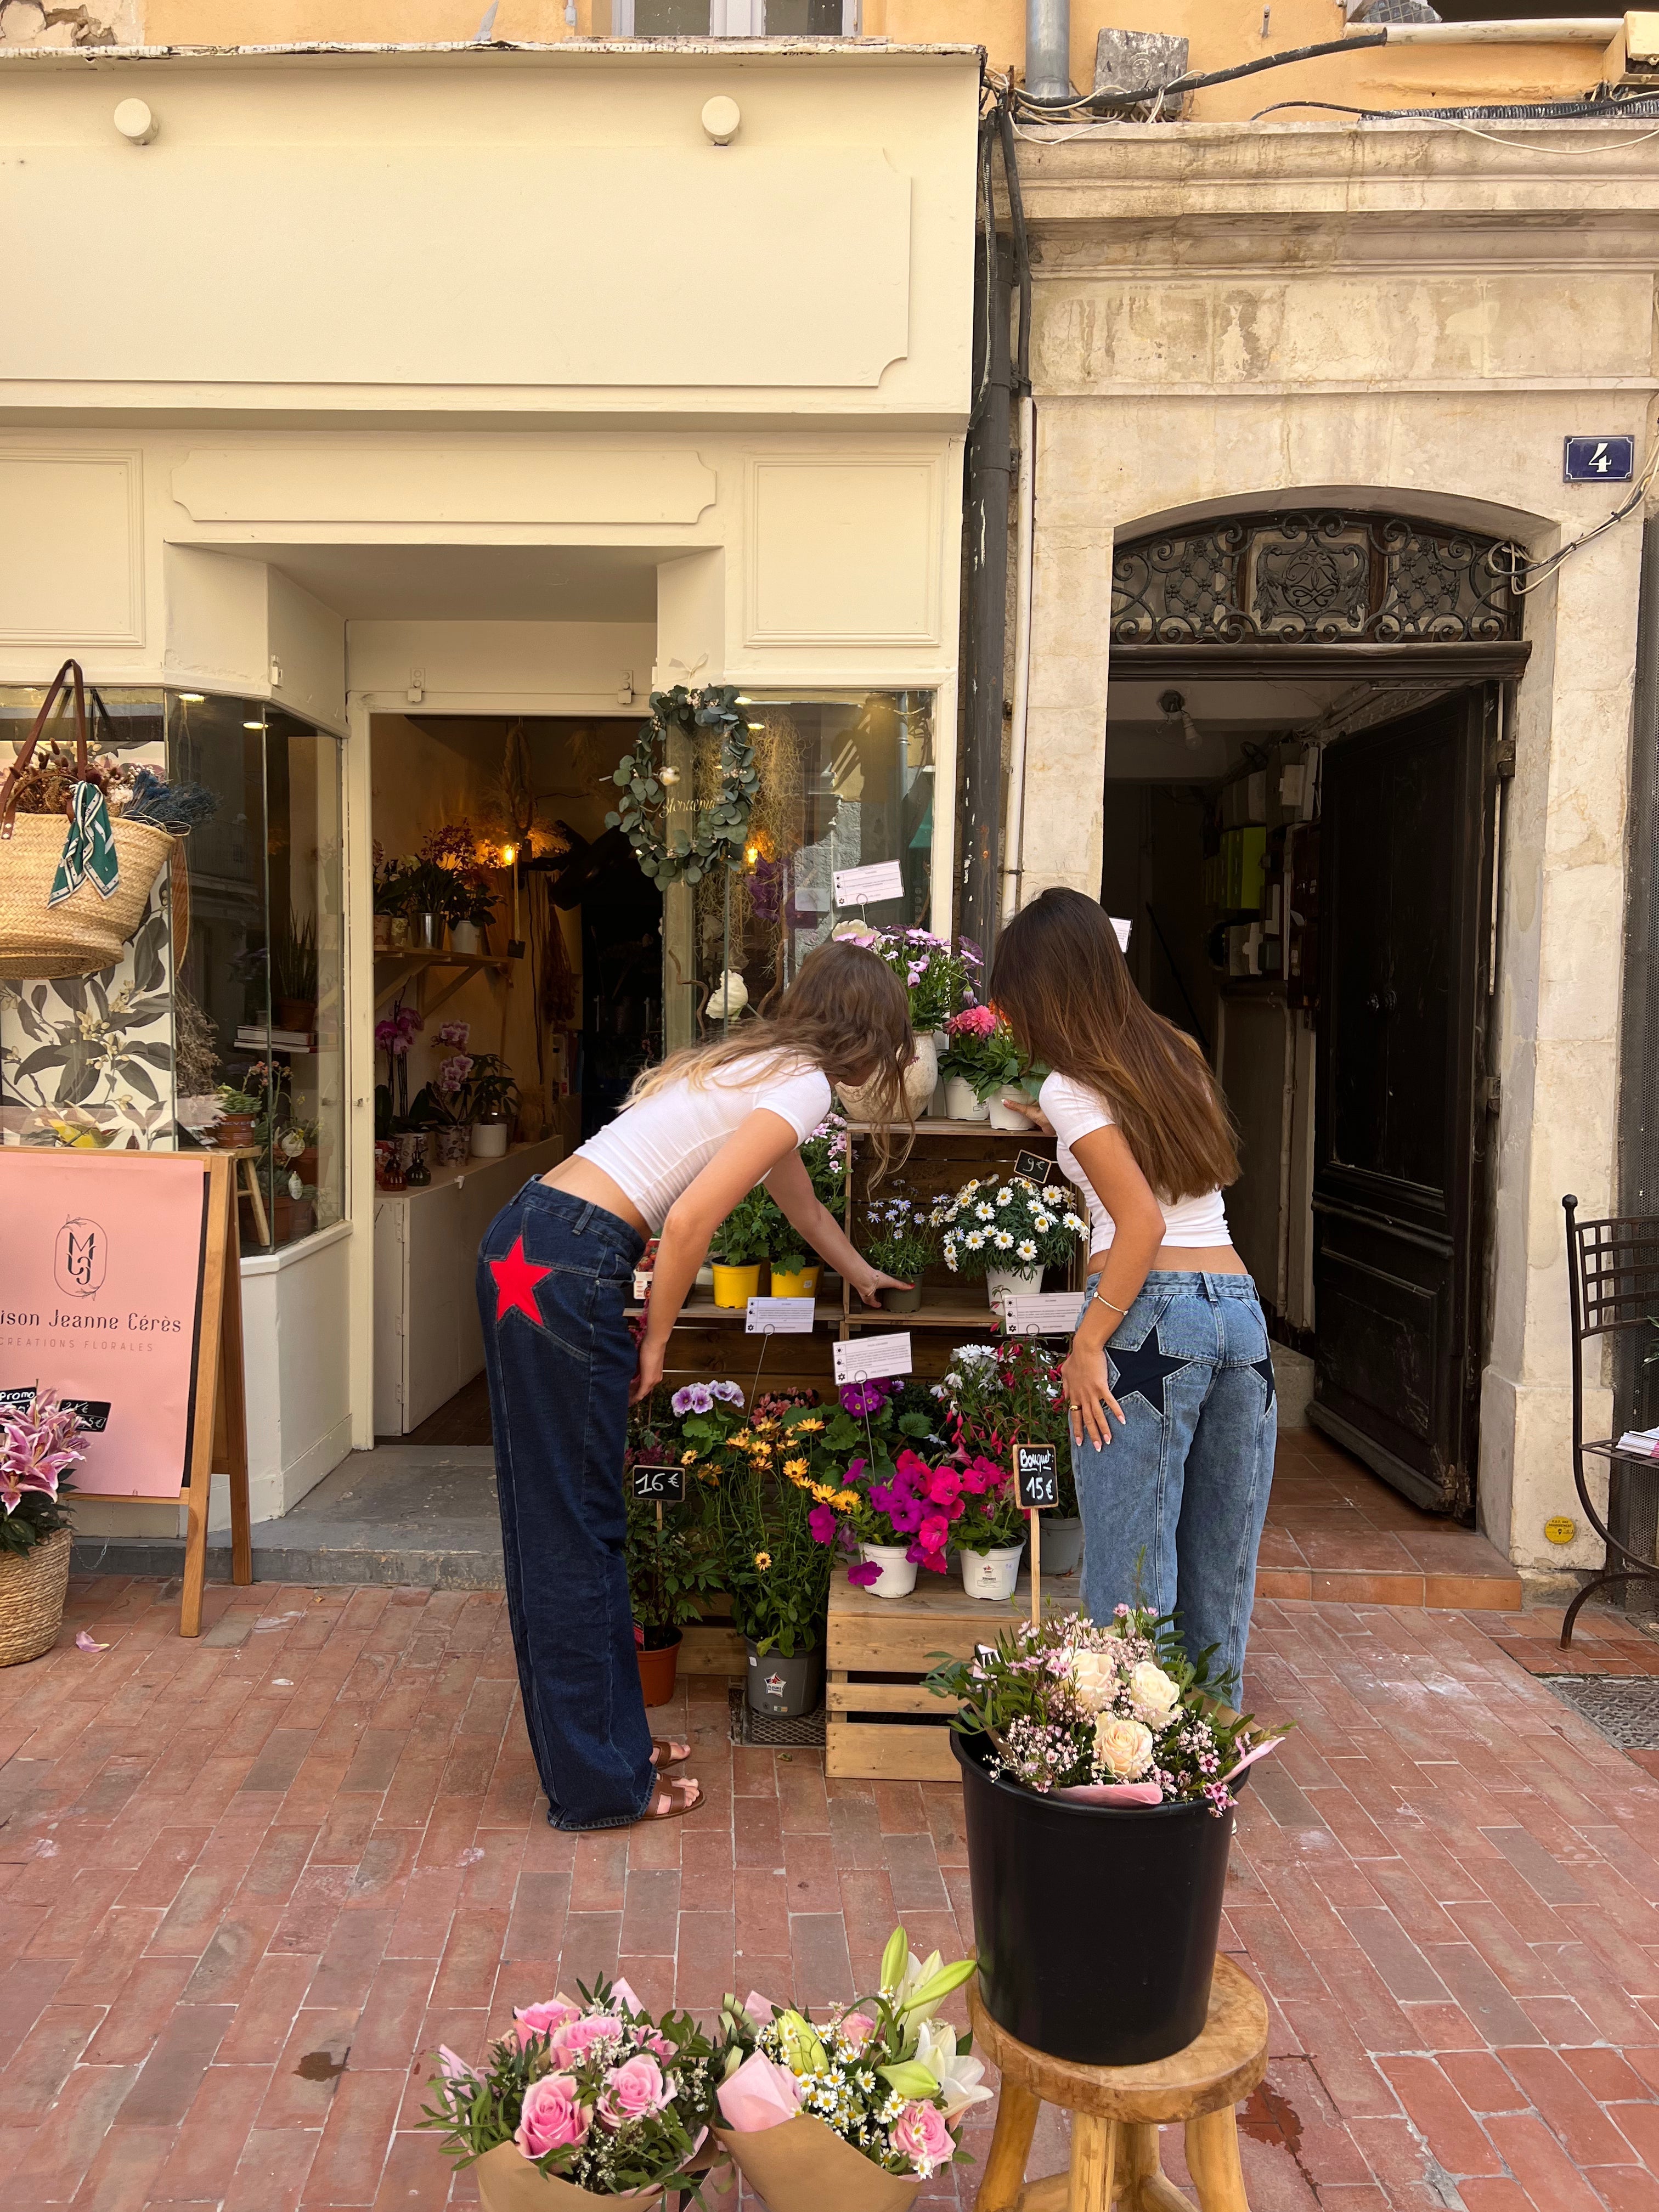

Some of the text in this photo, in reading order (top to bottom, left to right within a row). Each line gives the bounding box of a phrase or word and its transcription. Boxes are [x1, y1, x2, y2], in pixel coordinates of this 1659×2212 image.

[1588, 443, 1612, 472] 4
[49, 1310, 119, 1330] Jeanne
[128, 1312, 182, 1333] Cérès
[84, 1340, 153, 1352] FLORALES
[1026, 1476, 1053, 1500] 15€
